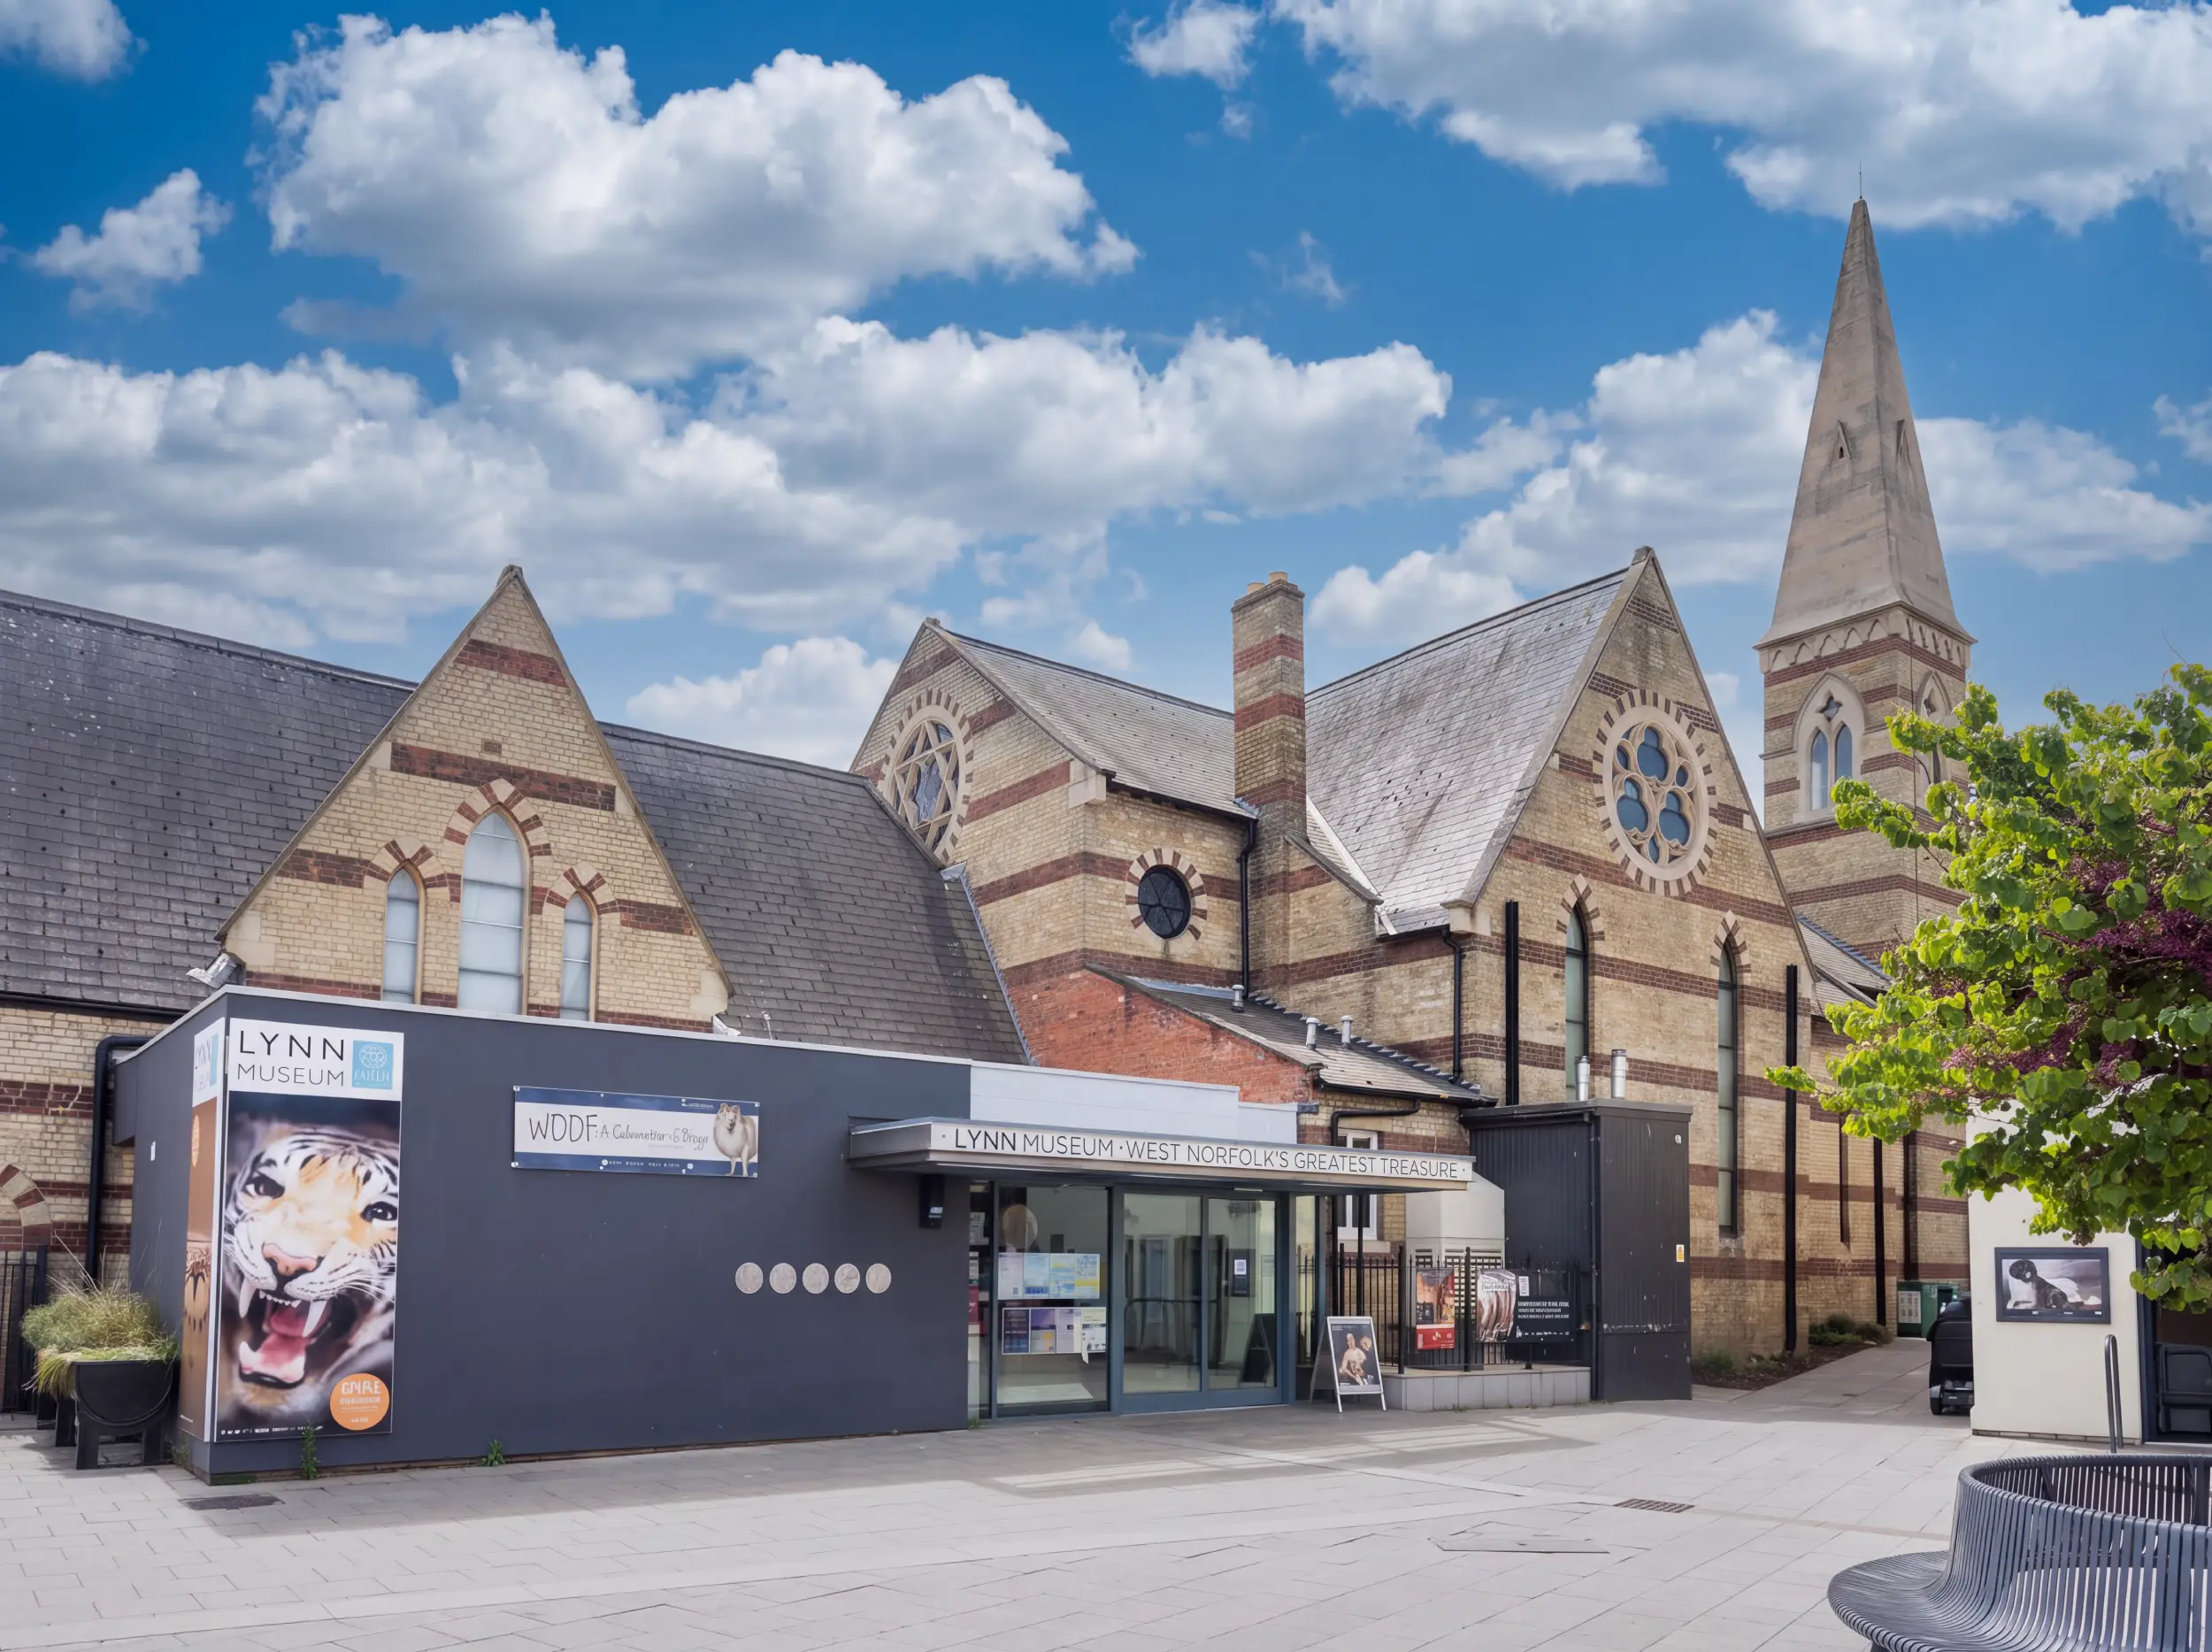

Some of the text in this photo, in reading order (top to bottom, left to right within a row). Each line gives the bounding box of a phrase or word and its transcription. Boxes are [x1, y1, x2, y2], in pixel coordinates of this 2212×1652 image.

[240, 1030, 344, 1061] LYNN
[237, 1064, 344, 1087] MUSEUM
[955, 1128, 1458, 1179] LYNN MUSEUM WEST NORFOLK'S GREATEST TREASURE
